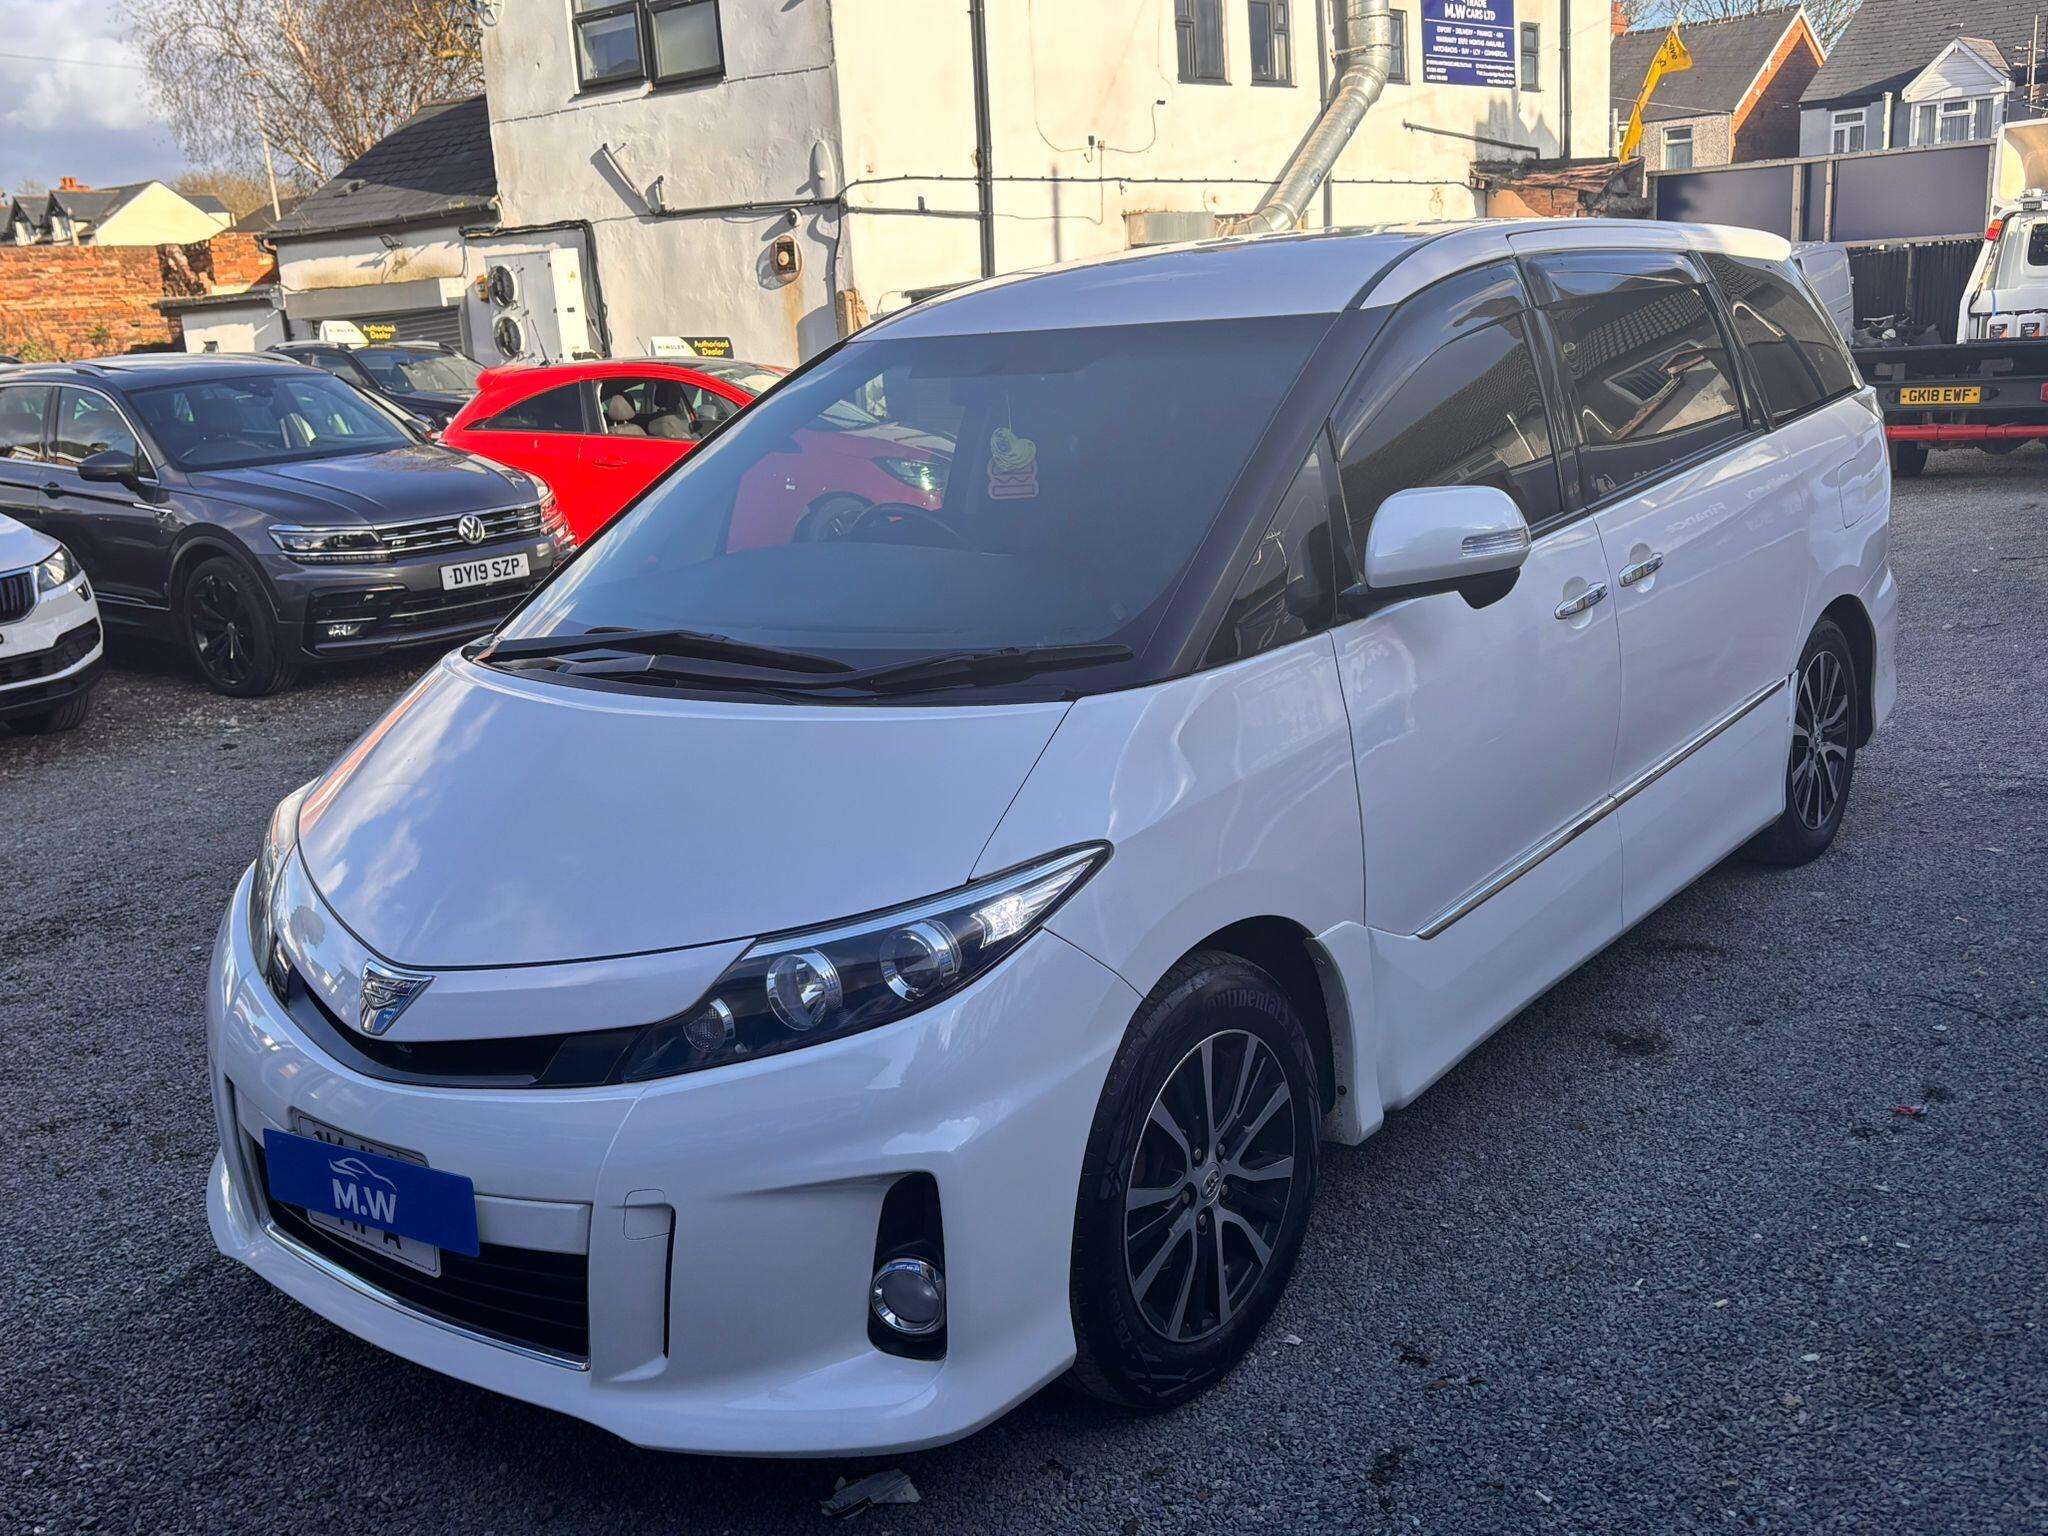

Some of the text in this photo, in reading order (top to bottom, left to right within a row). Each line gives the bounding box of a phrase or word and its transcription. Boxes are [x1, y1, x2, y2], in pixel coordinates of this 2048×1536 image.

[1444, 3, 1496, 21] M.W CARS LTD
[363, 324, 396, 333] Authorised
[370, 331, 391, 339] Dealer
[694, 339, 730, 348] Authorised
[702, 347, 725, 356] Dealer
[1908, 388, 1972, 402] GK18 EWF
[452, 558, 520, 585] DY19 SZP
[332, 1178, 397, 1224] M.W
